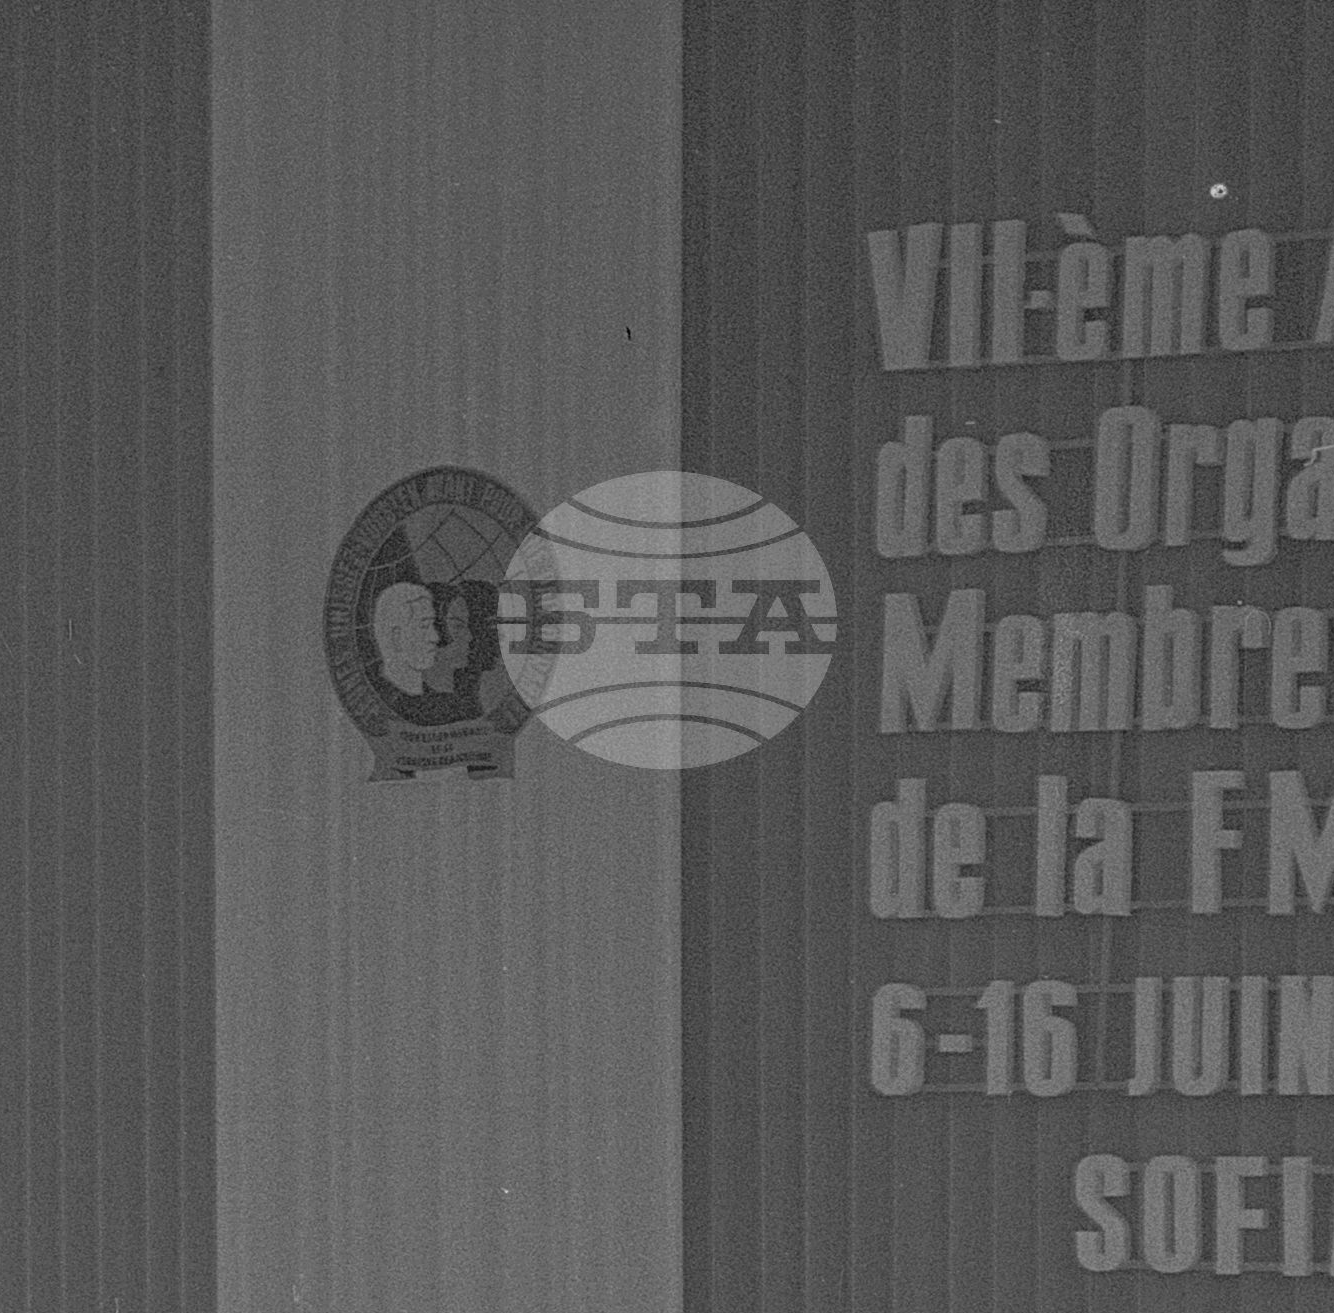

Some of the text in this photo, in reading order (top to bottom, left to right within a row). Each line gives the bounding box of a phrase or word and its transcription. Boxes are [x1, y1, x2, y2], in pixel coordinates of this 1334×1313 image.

[864, 212, 1274, 372] VII-ème
[874, 414, 1050, 559] des
[869, 777, 987, 920] de
[1034, 774, 1134, 917] la
[869, 979, 1079, 1098] 6-16
